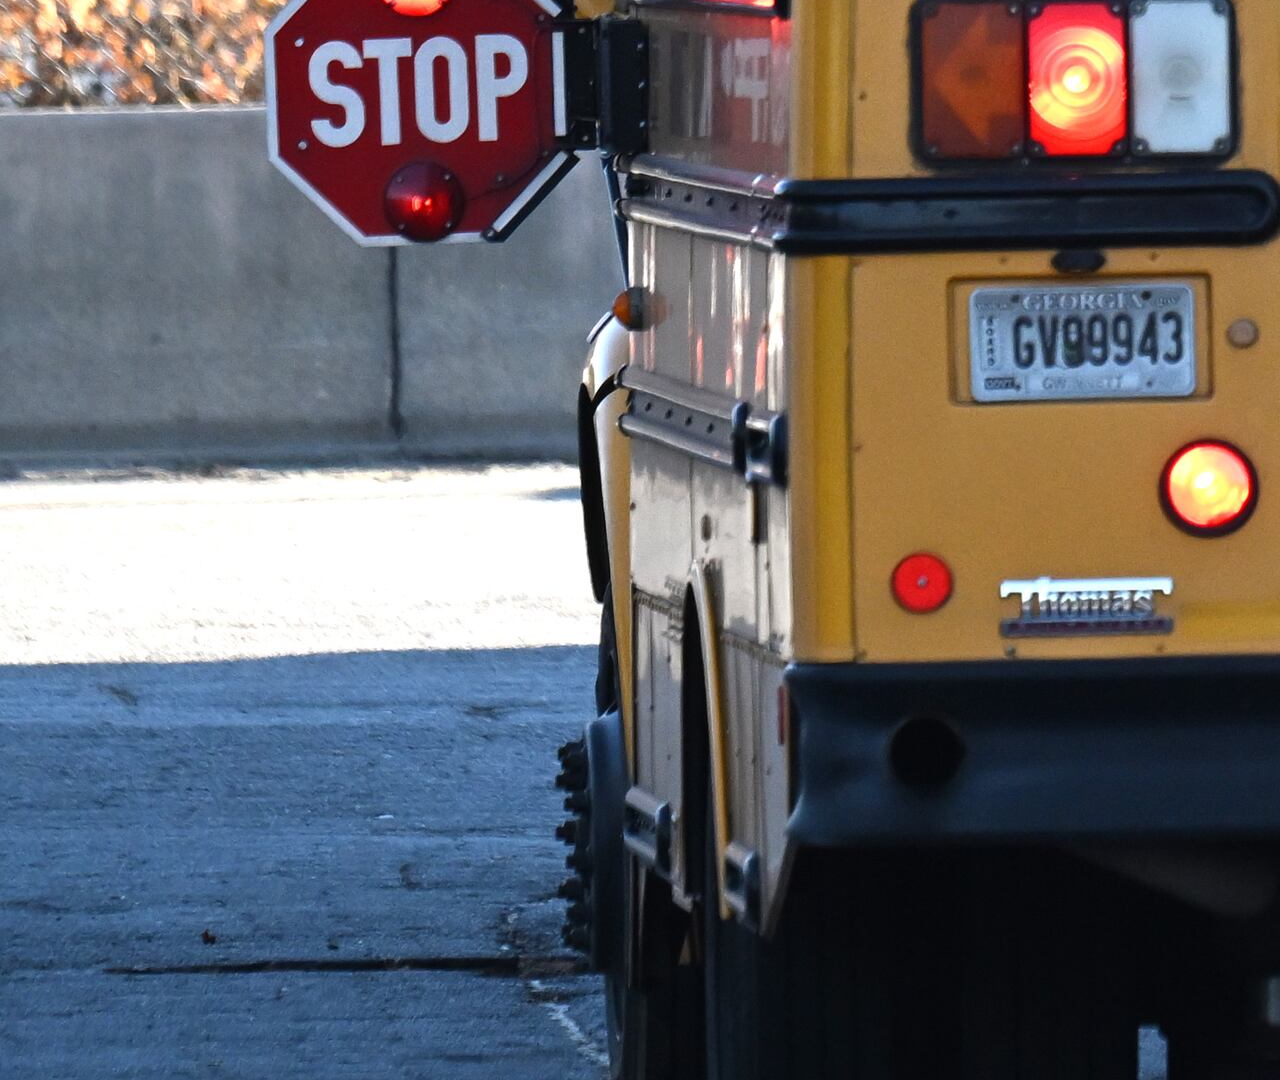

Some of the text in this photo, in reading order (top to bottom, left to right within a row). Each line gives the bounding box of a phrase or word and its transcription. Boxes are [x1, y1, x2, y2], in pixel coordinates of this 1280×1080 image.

[308, 33, 528, 148] STOP
[1022, 292, 1143, 310] GEORGIA
[1000, 577, 1173, 619] Thomas
